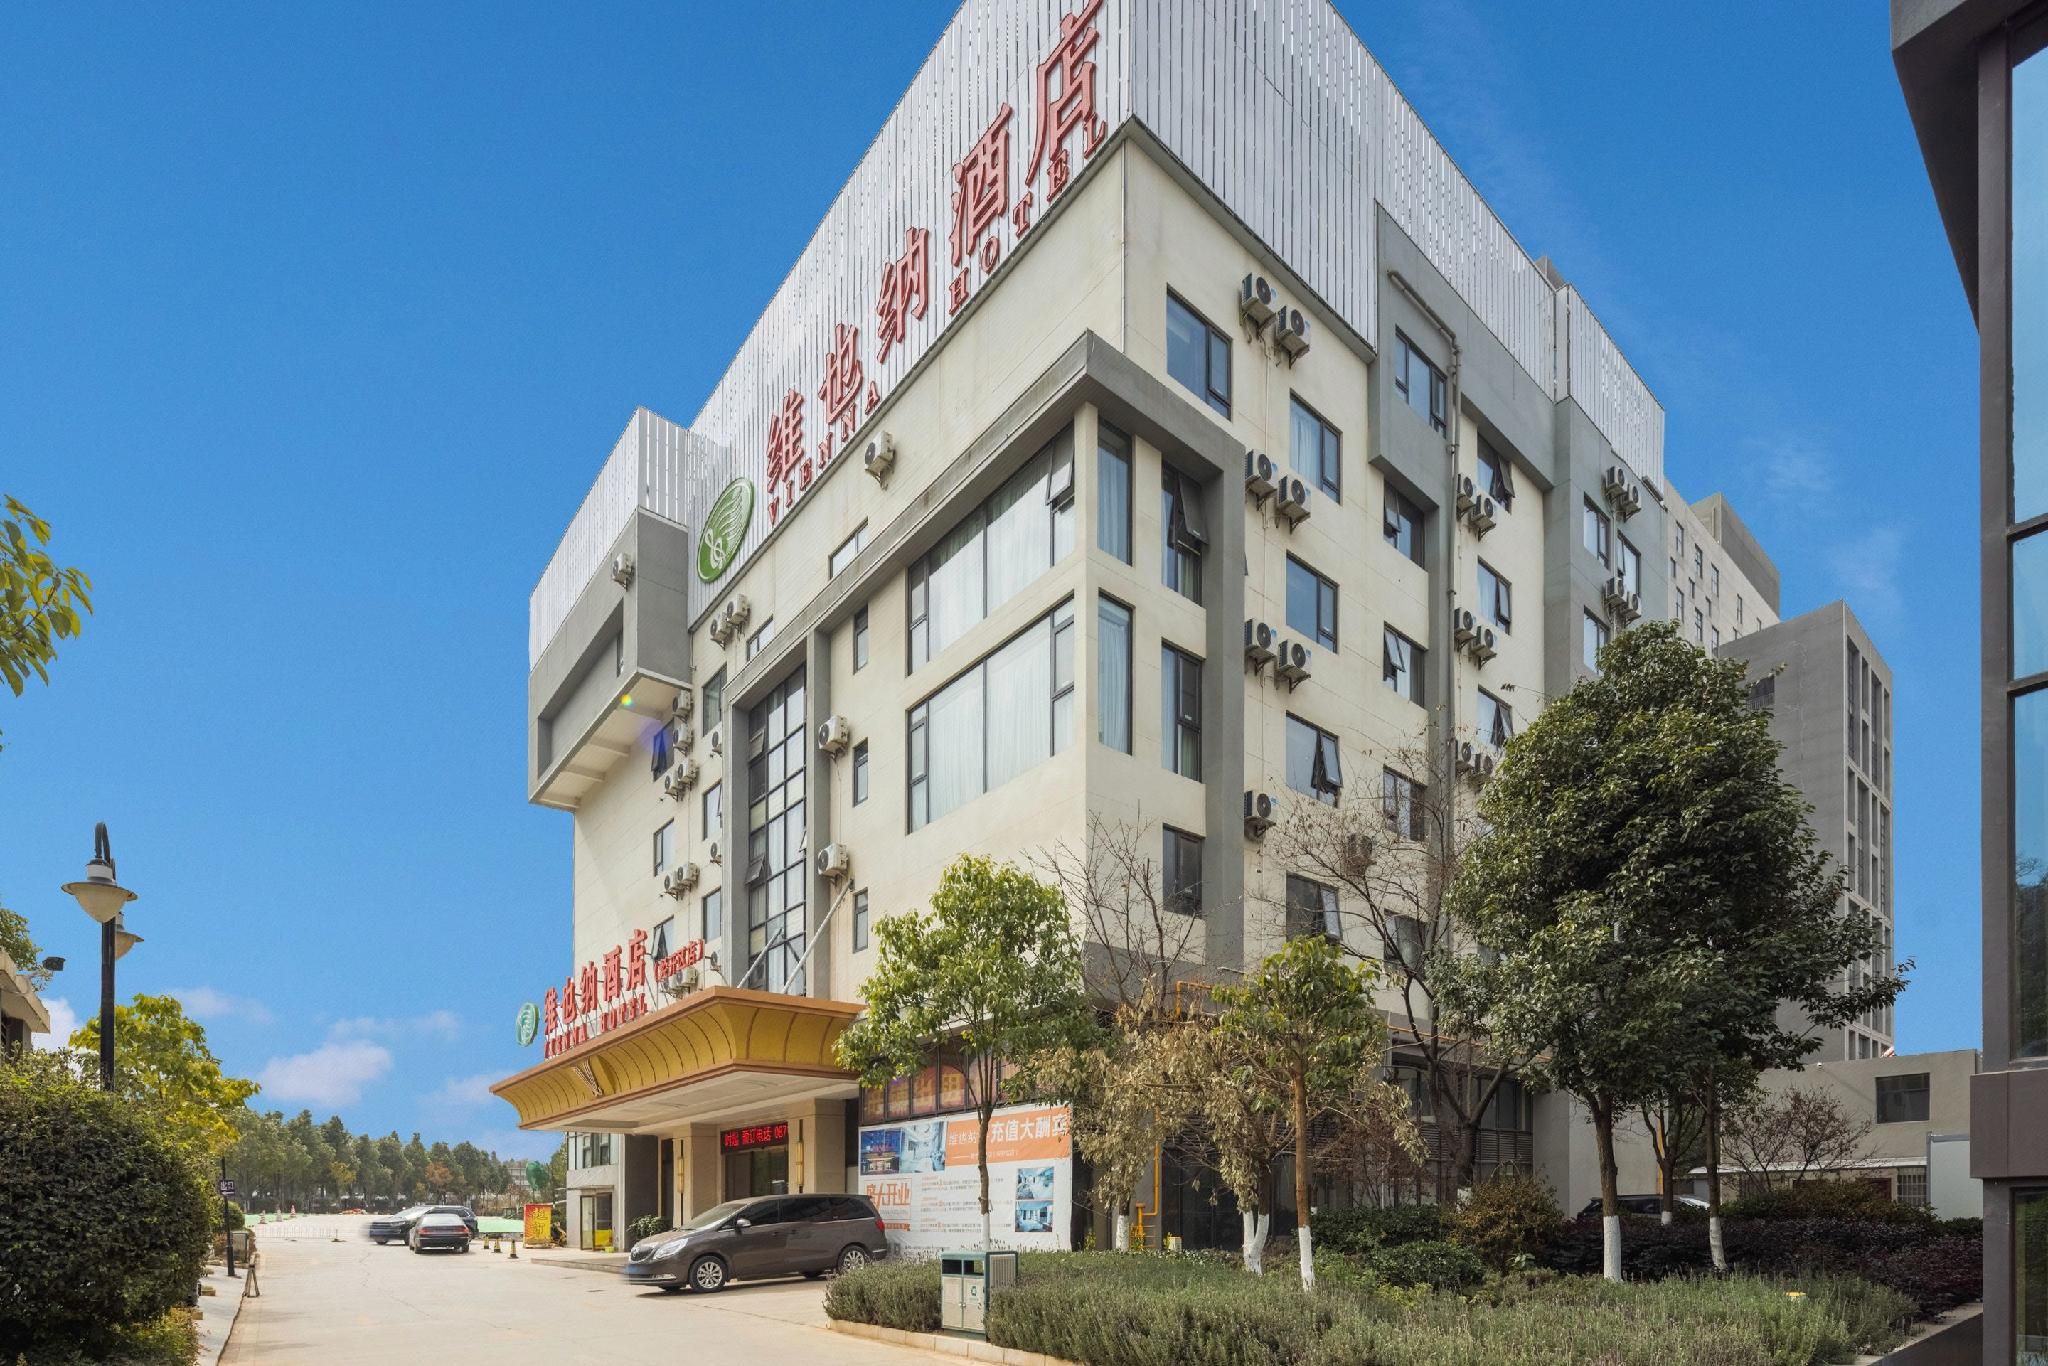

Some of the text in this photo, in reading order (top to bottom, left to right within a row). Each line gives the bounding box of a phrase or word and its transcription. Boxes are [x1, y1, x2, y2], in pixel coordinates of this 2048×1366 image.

[767, 0, 1101, 493] 维也纳酒店
[768, 112, 1106, 525] VIENNA HOTEL
[544, 928, 648, 1035] 维也纳酒店
